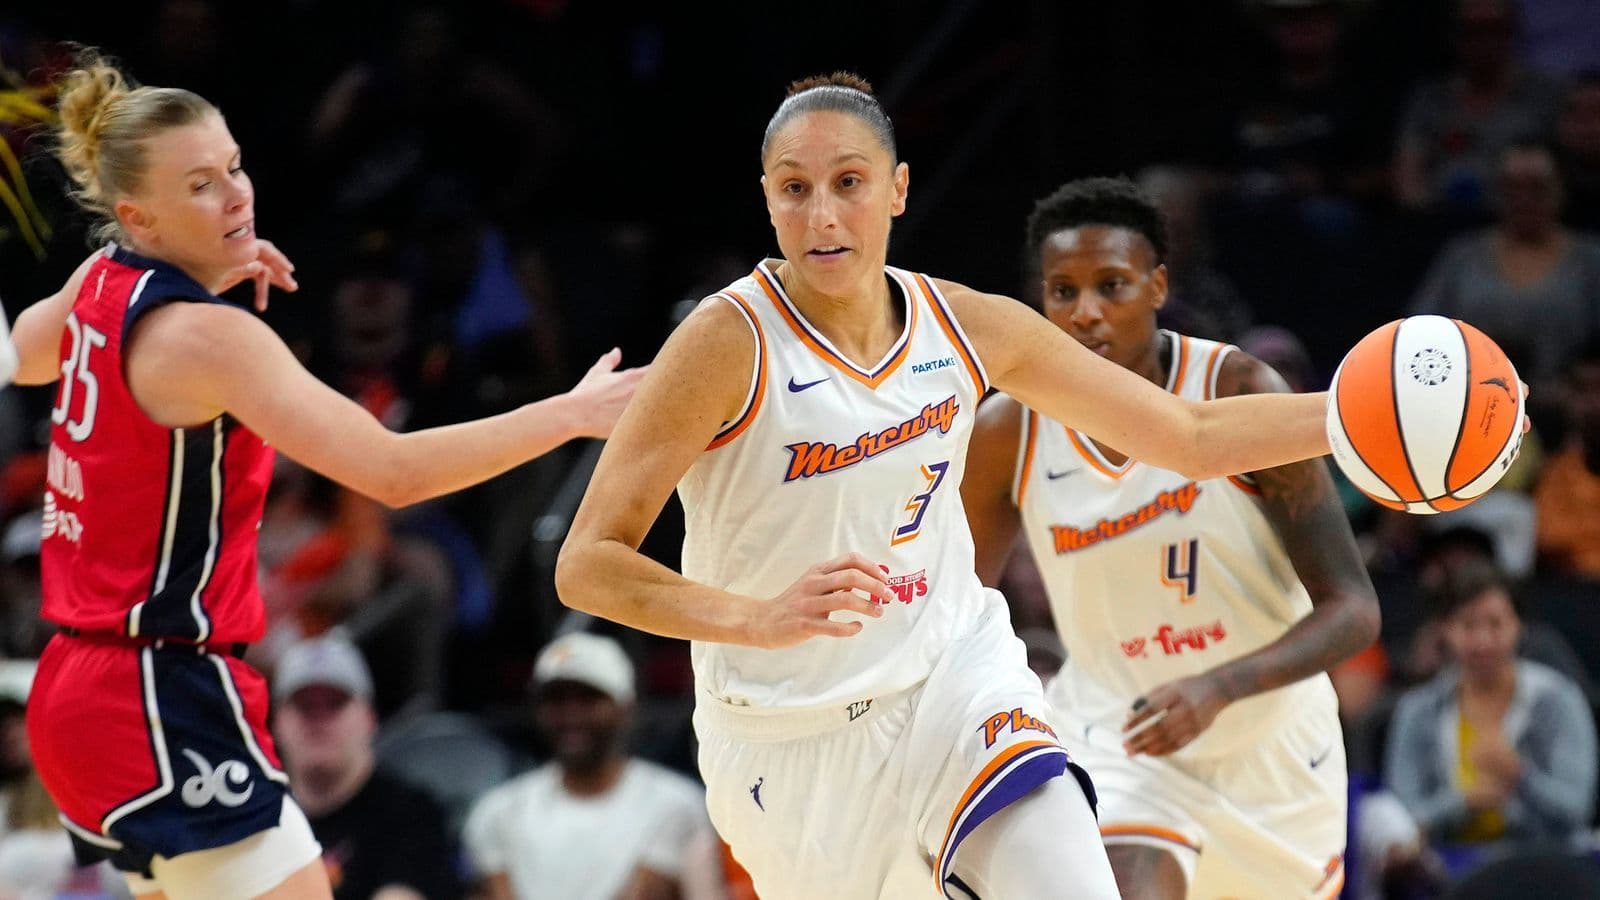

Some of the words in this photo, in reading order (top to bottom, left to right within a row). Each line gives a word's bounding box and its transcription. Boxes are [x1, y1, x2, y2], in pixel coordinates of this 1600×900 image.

[784, 394, 960, 483] Mercury
[891, 460, 950, 547] 3
[1049, 481, 1202, 556] Mercury
[1160, 537, 1199, 605] 4
